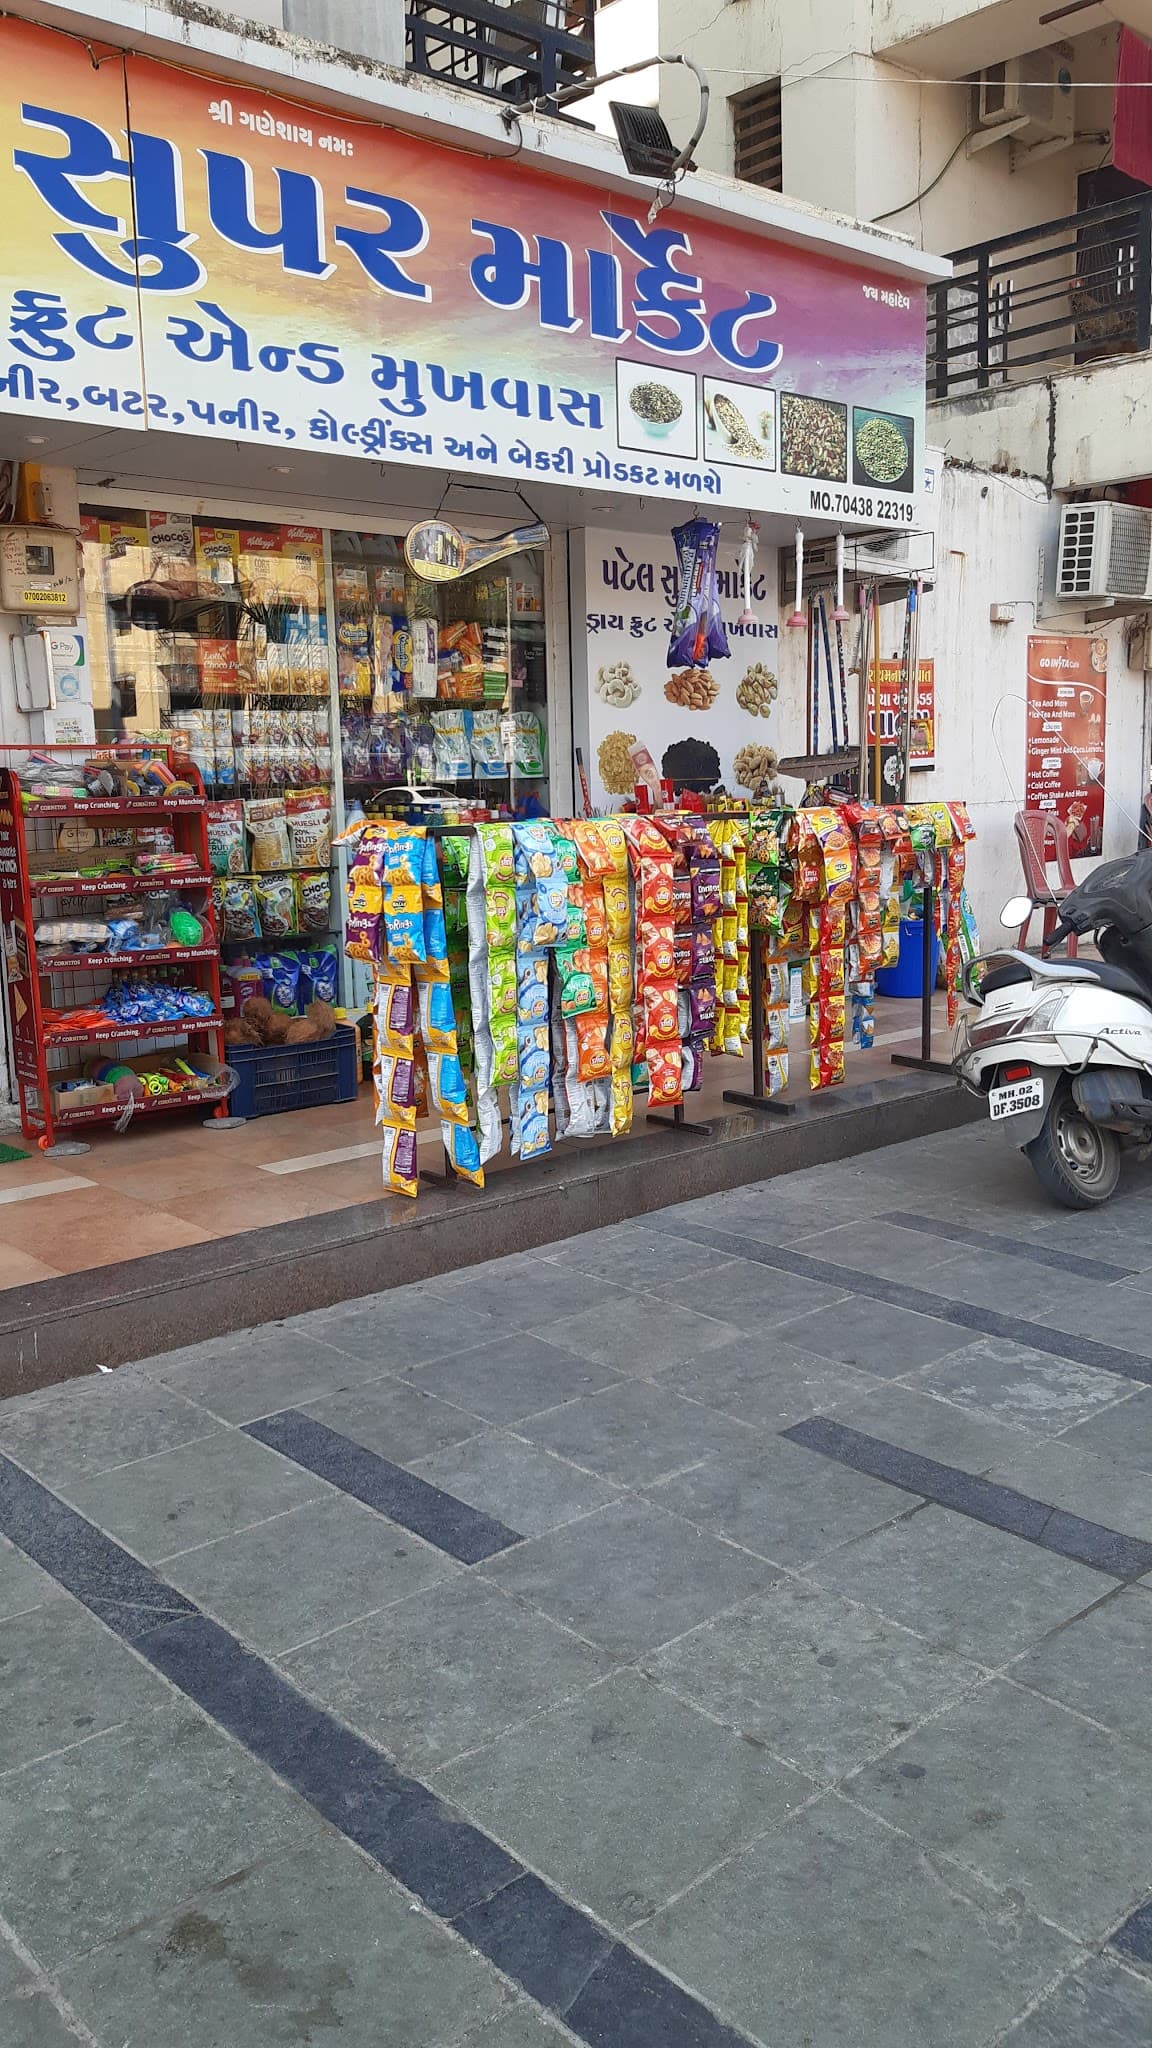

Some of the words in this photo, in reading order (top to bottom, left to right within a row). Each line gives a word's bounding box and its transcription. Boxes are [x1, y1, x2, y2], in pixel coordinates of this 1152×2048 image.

[208, 99, 233, 126] શ્રી
[239, 109, 313, 147] ગણેશાય
[13, 102, 432, 303] સુપર
[469, 210, 783, 373] માર્કેટ
[862, 285, 878, 301] જય
[881, 289, 910, 310] મહાદેવ
[166, 300, 344, 384] એન્ડ
[370, 353, 603, 429] મુખવાસ
[443, 433, 498, 464] અને
[508, 438, 574, 475] બેકરી
[664, 468, 722, 495] મળશે
[810, 490, 873, 517] MO.70438
[877, 499, 914, 522] 22319
[151, 531, 192, 545] CHOCOS
[602, 546, 655, 593] પટેલ
[586, 613, 624, 635] ડ્રાય
[73, 802, 89, 810] Keep
[163, 798, 178, 806] Keep
[81, 883, 97, 891] Keep
[170, 877, 184, 885] Keep
[87, 957, 103, 965] Keep
[176, 950, 190, 958] Keep
[673, 950, 691, 959] oritos
[95, 1031, 110, 1040] Keep
[182, 1022, 196, 1030] Keep
[1096, 1026, 1142, 1036] Activa
[101, 1105, 117, 1114] Keep
[187, 1093, 201, 1101] Keep
[998, 1085, 1033, 1101] MH.02
[993, 1094, 1040, 1117] DF.3508
